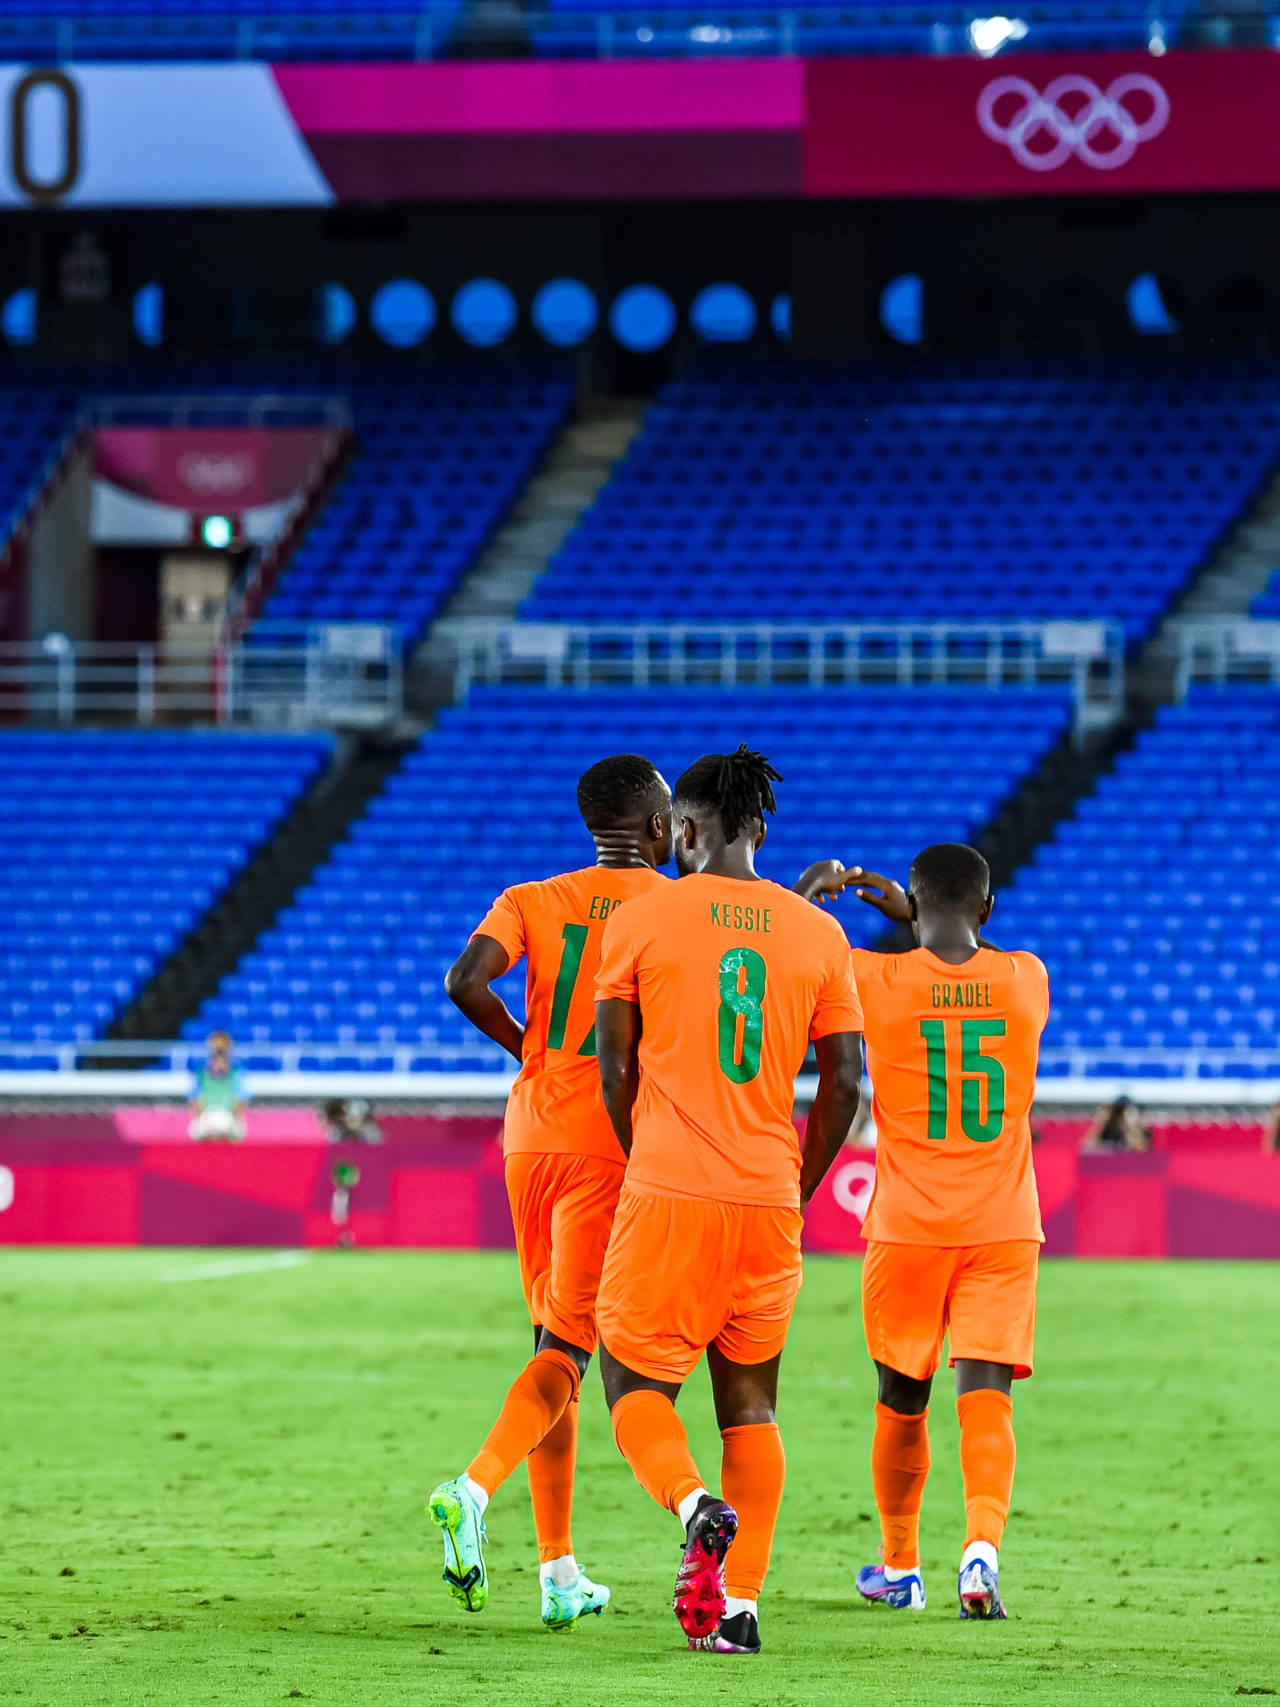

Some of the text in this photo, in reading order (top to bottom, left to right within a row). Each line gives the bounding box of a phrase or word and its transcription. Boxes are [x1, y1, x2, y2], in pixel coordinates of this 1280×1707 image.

[711, 902, 772, 933] KESSIE
[547, 923, 601, 1057] 1
[719, 947, 767, 1084] 8
[932, 982, 993, 1008] GRADEL
[920, 1019, 1006, 1142] 15
